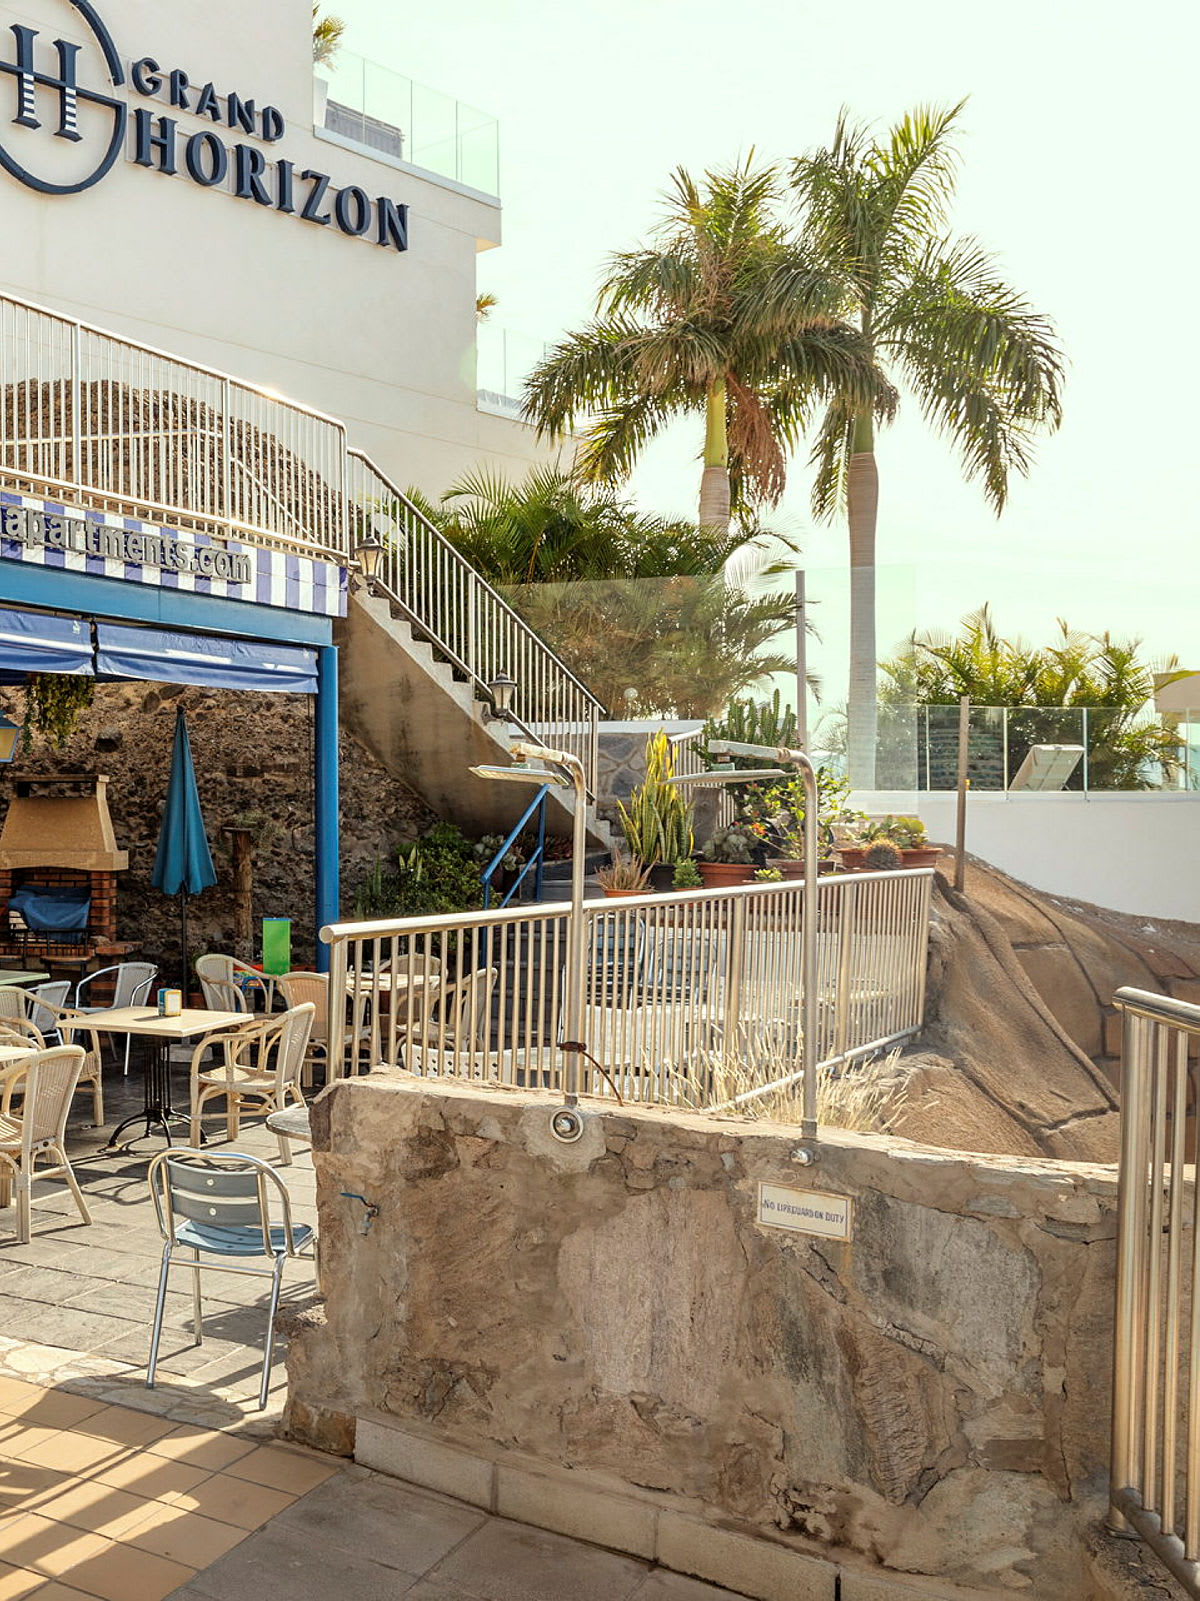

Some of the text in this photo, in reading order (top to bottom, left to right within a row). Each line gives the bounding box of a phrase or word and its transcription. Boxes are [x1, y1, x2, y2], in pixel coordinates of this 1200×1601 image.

[132, 57, 285, 142] GRAND
[133, 108, 410, 252] HORIZON
[763, 1199, 775, 1210] NO
[825, 1212, 844, 1223] DUTY
